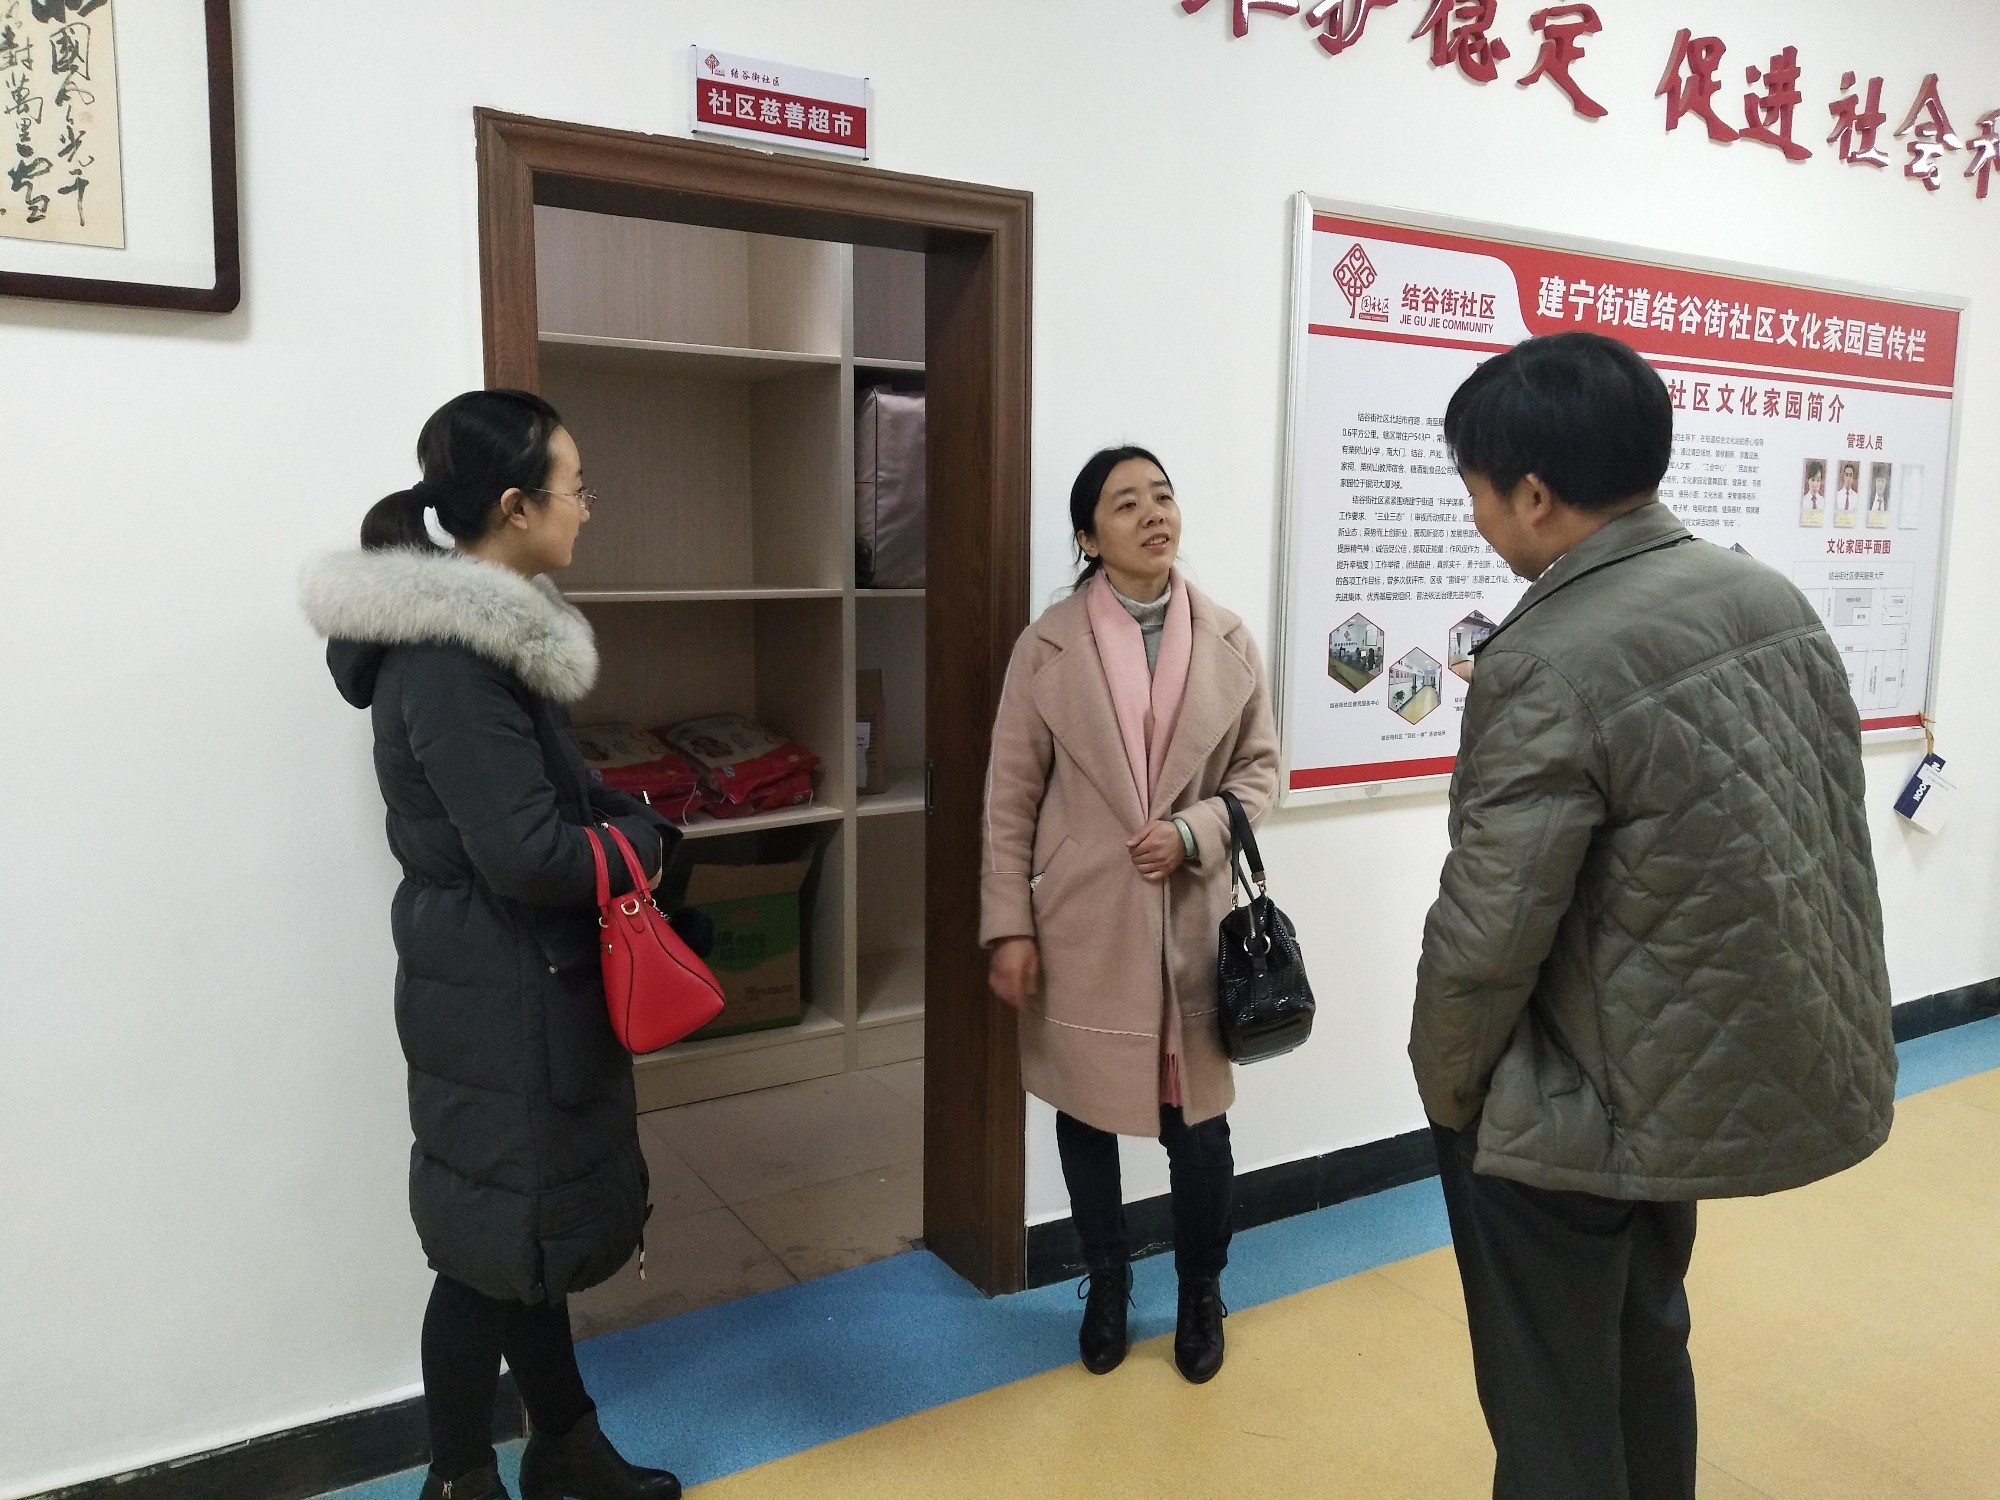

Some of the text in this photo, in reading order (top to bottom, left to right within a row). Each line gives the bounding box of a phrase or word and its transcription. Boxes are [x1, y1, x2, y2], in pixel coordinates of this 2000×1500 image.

[1181, 0, 1609, 121] 稳定
[730, 68, 780, 87] 结谷街社区
[707, 87, 853, 138] 社区慈善超市
[1401, 283, 1496, 320] 结谷街社区
[1400, 313, 1494, 334] JIE GU JIE COMMUNITY
[1537, 273, 1928, 365] 建宁街道结谷街社区文化家园宣传栏
[1846, 432, 1884, 451] 管理人员
[1826, 538, 1892, 555] 文化家园平面图
